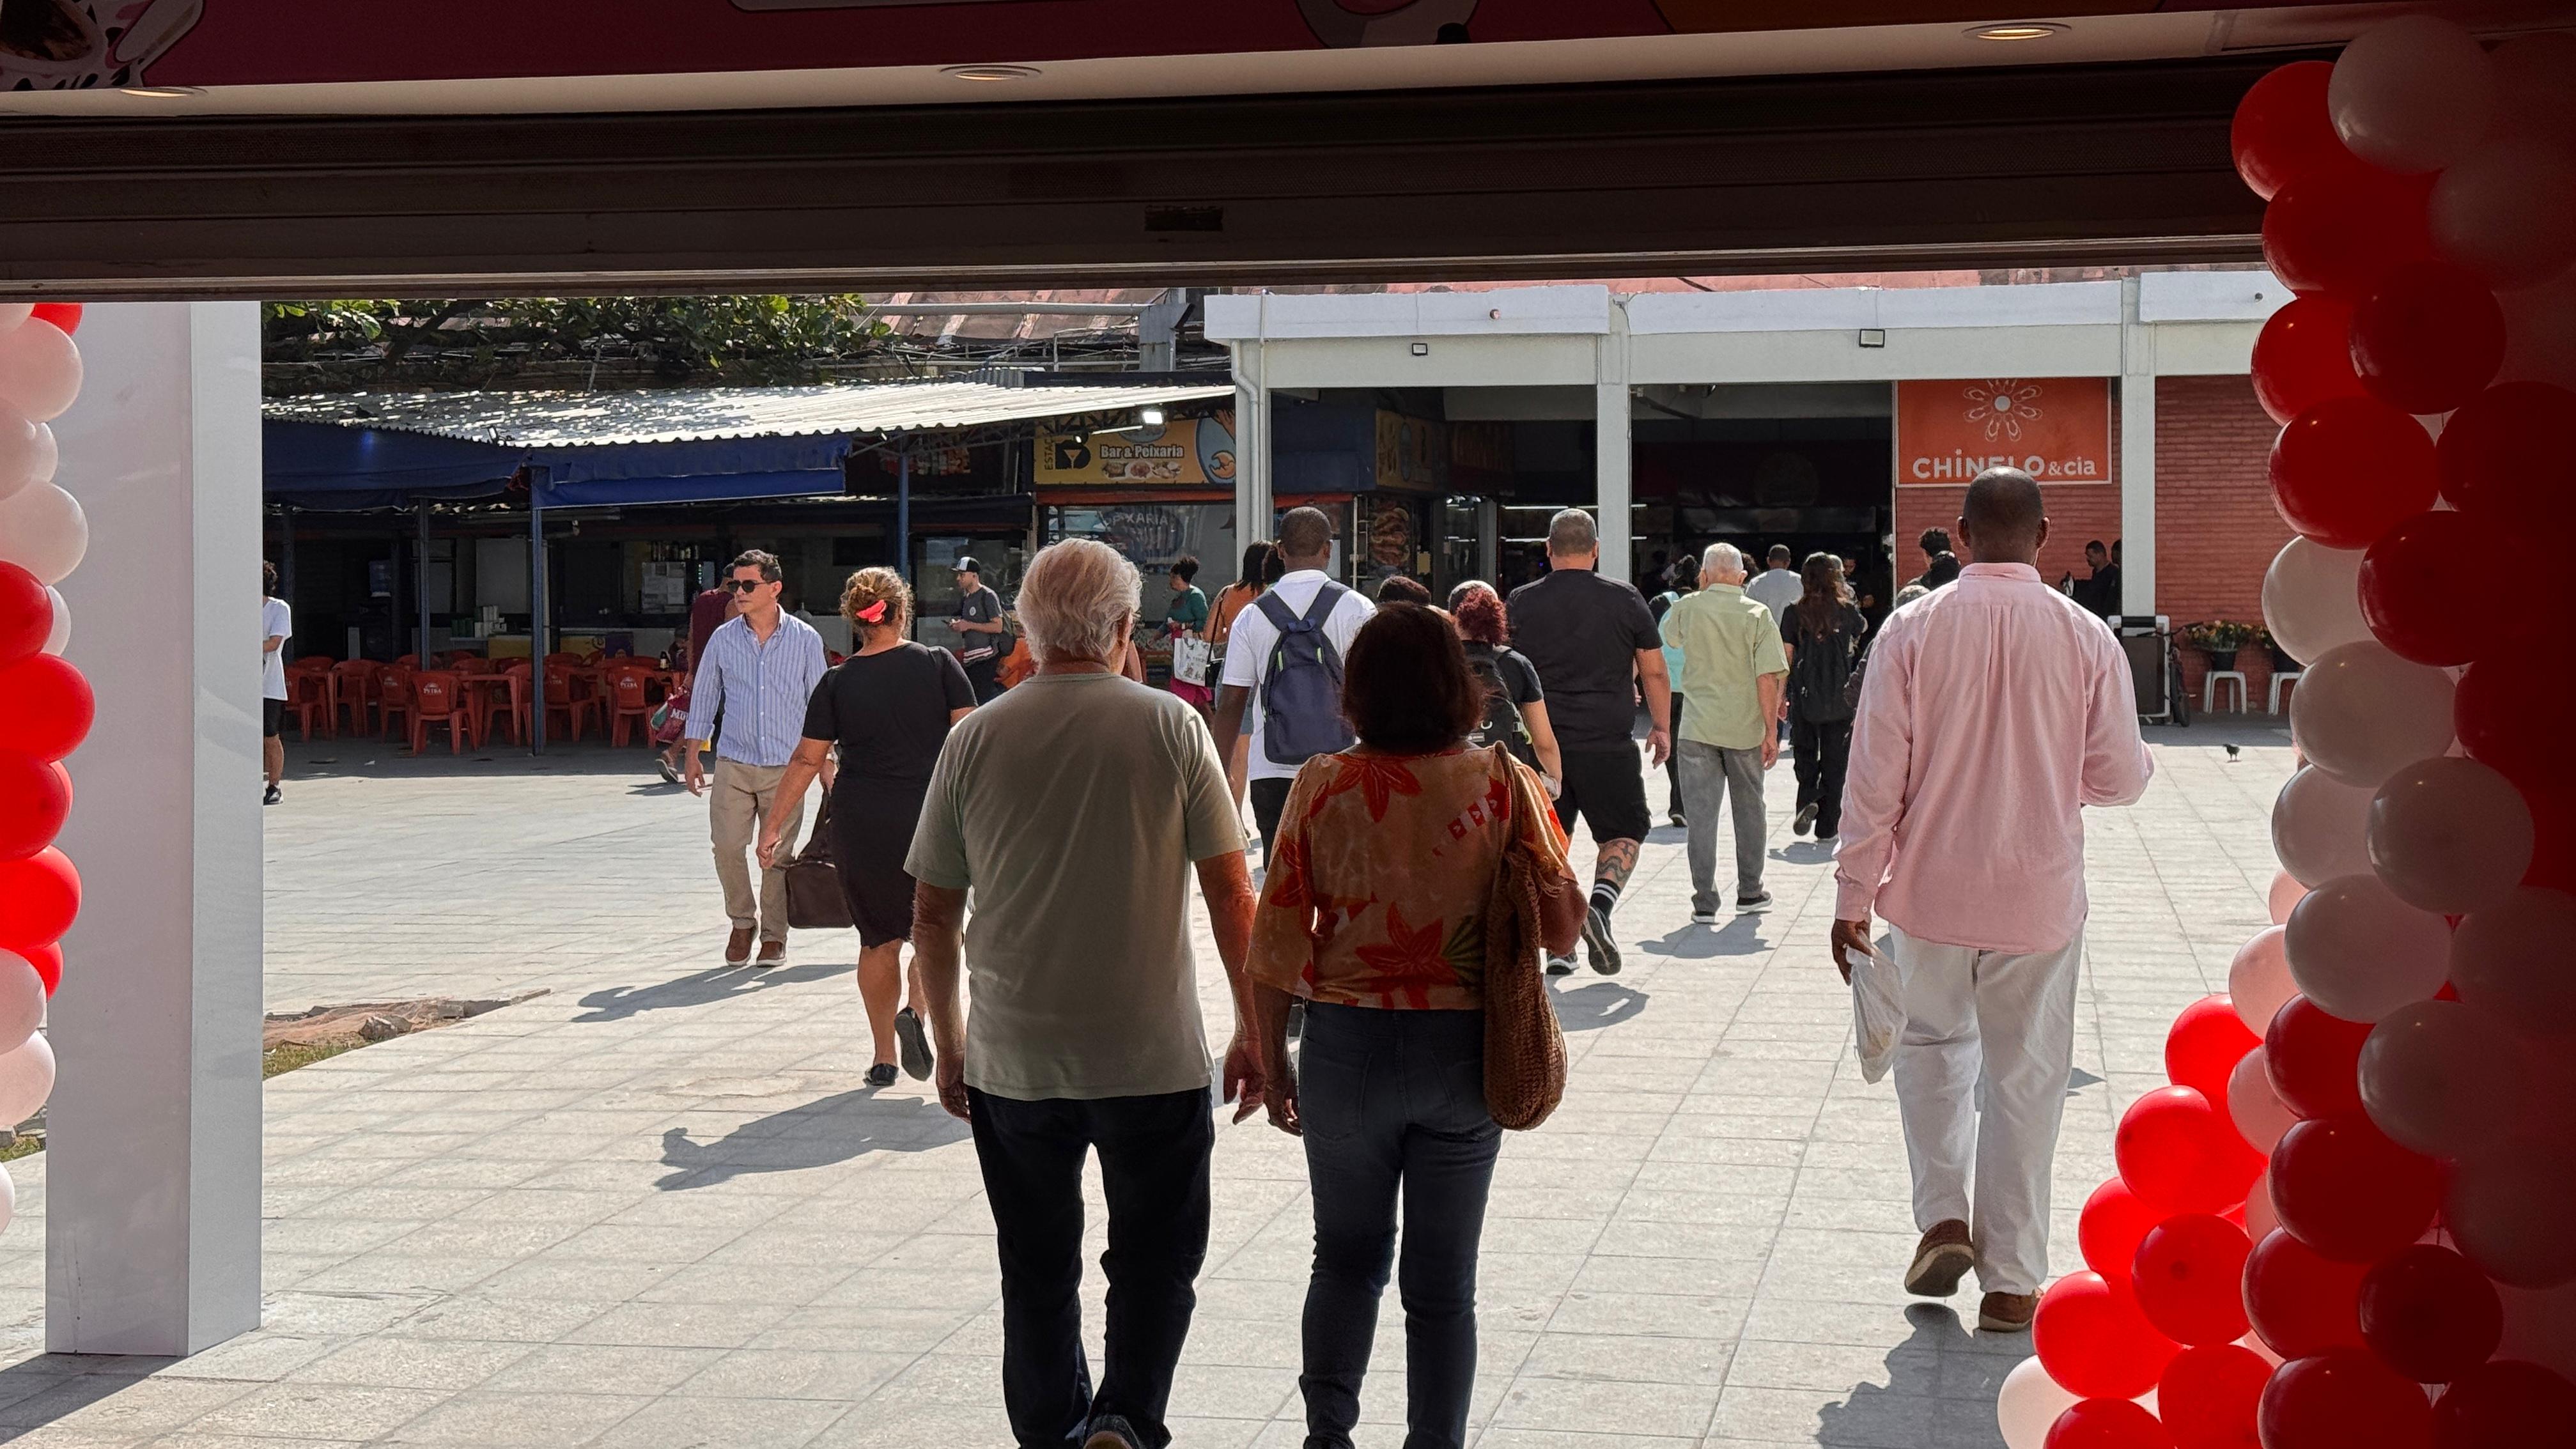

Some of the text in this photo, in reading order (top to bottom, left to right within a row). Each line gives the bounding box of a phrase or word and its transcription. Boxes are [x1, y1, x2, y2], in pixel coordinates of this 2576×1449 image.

[1101, 444, 1184, 459] Bar & Peixaria
